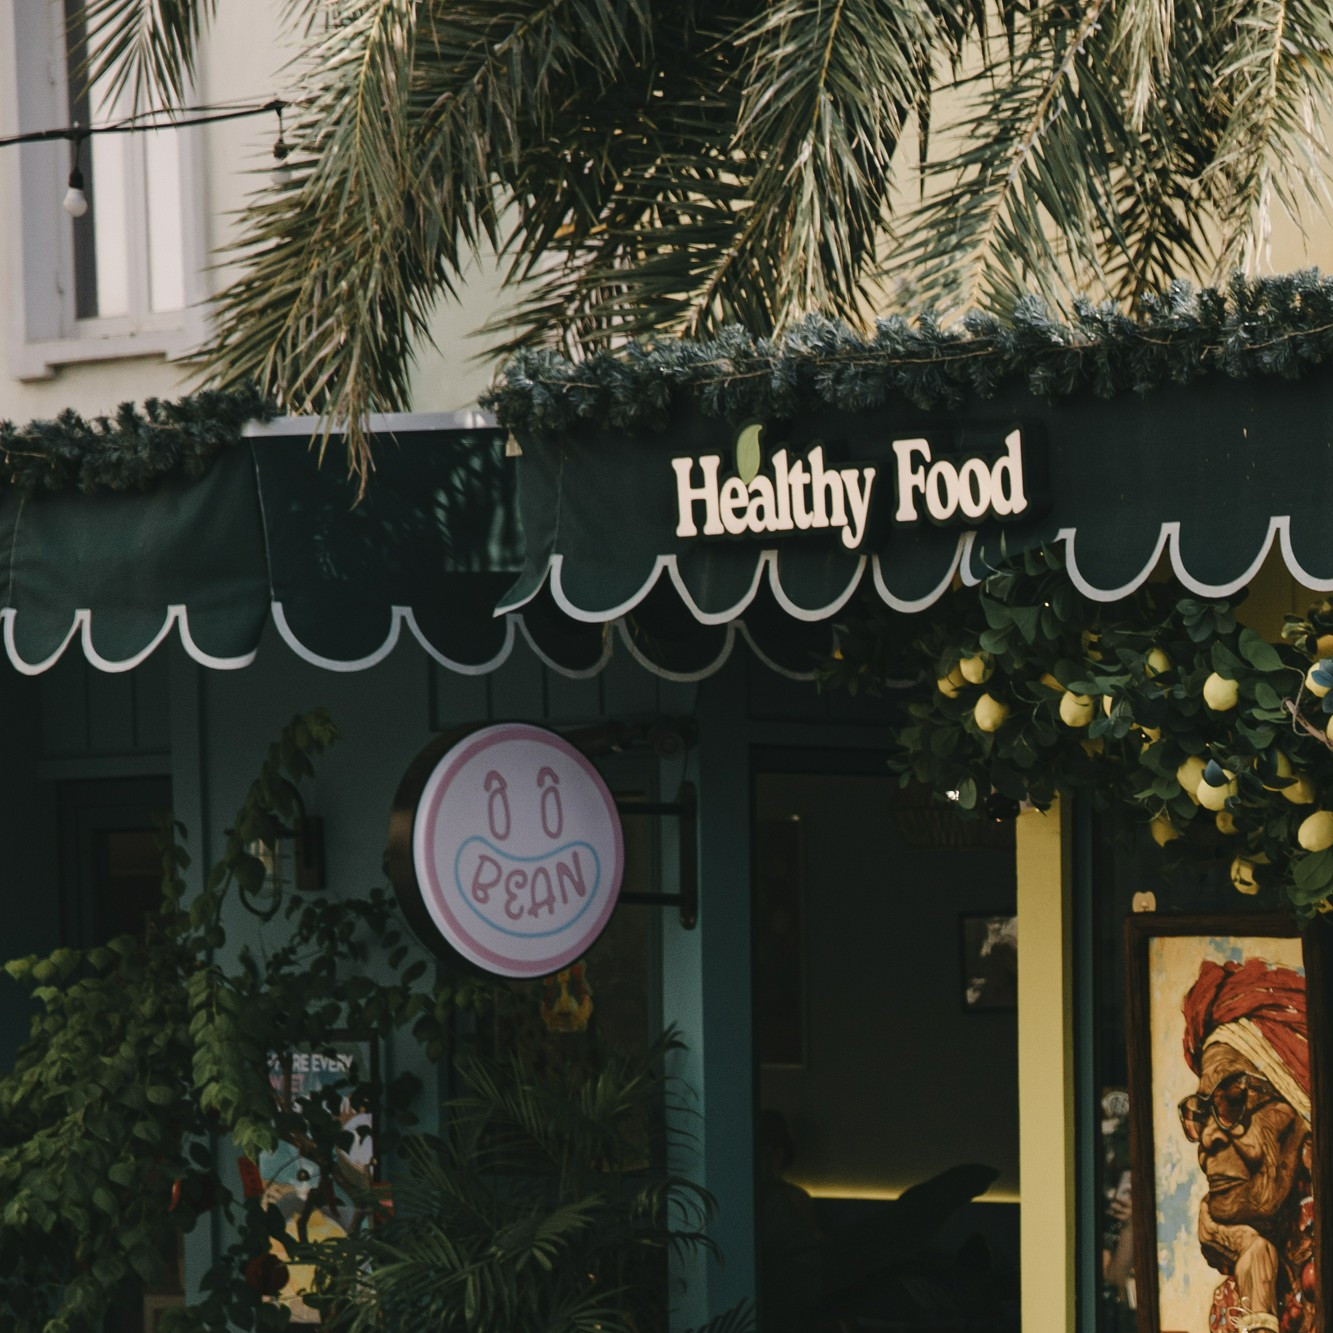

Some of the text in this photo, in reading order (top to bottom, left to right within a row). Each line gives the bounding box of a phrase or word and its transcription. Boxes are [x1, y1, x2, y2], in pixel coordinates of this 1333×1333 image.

[672, 429, 1028, 549] Healthy Food
[472, 851, 586, 920] BEAN
